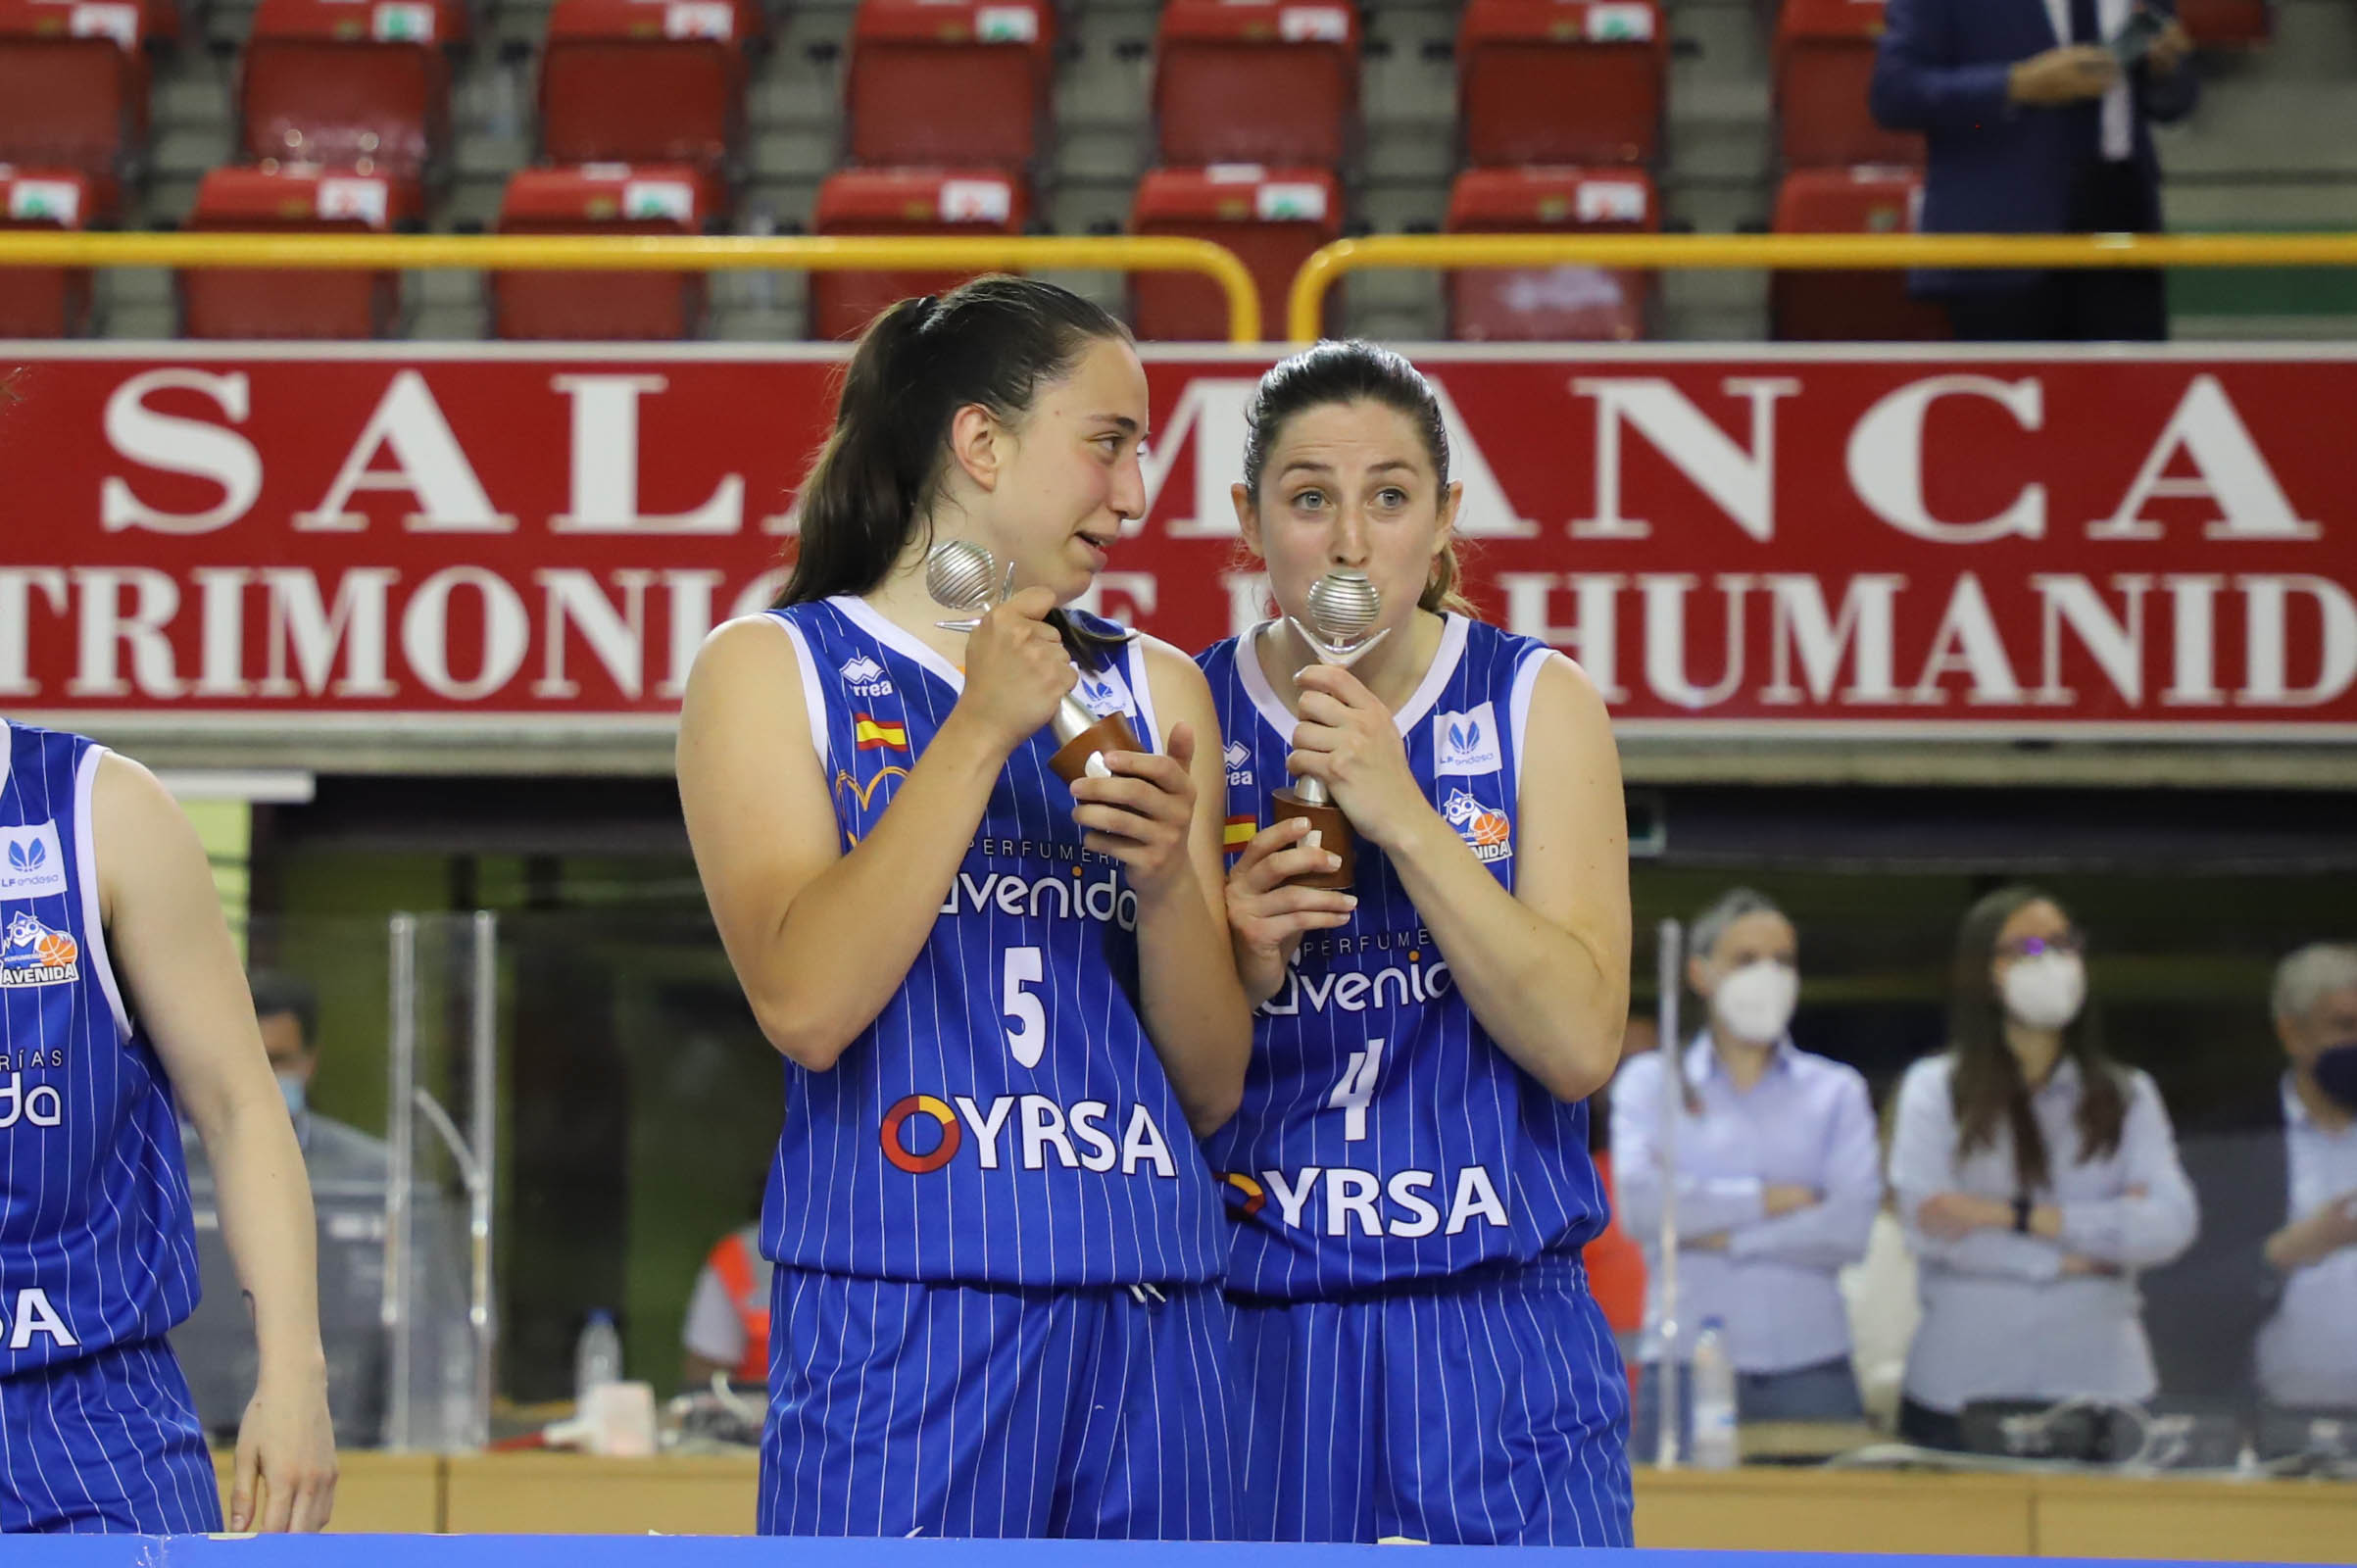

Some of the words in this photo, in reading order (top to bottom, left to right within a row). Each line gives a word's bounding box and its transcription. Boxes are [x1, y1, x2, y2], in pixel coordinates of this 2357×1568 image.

[101, 368, 2324, 544] SALMANCA
[0, 565, 798, 702] TRIMONI
[849, 680, 893, 697] rrea
[2, 962, 76, 984] AVENIDA
[1004, 947, 1046, 1068] 5
[1328, 1038, 1385, 1141] 4
